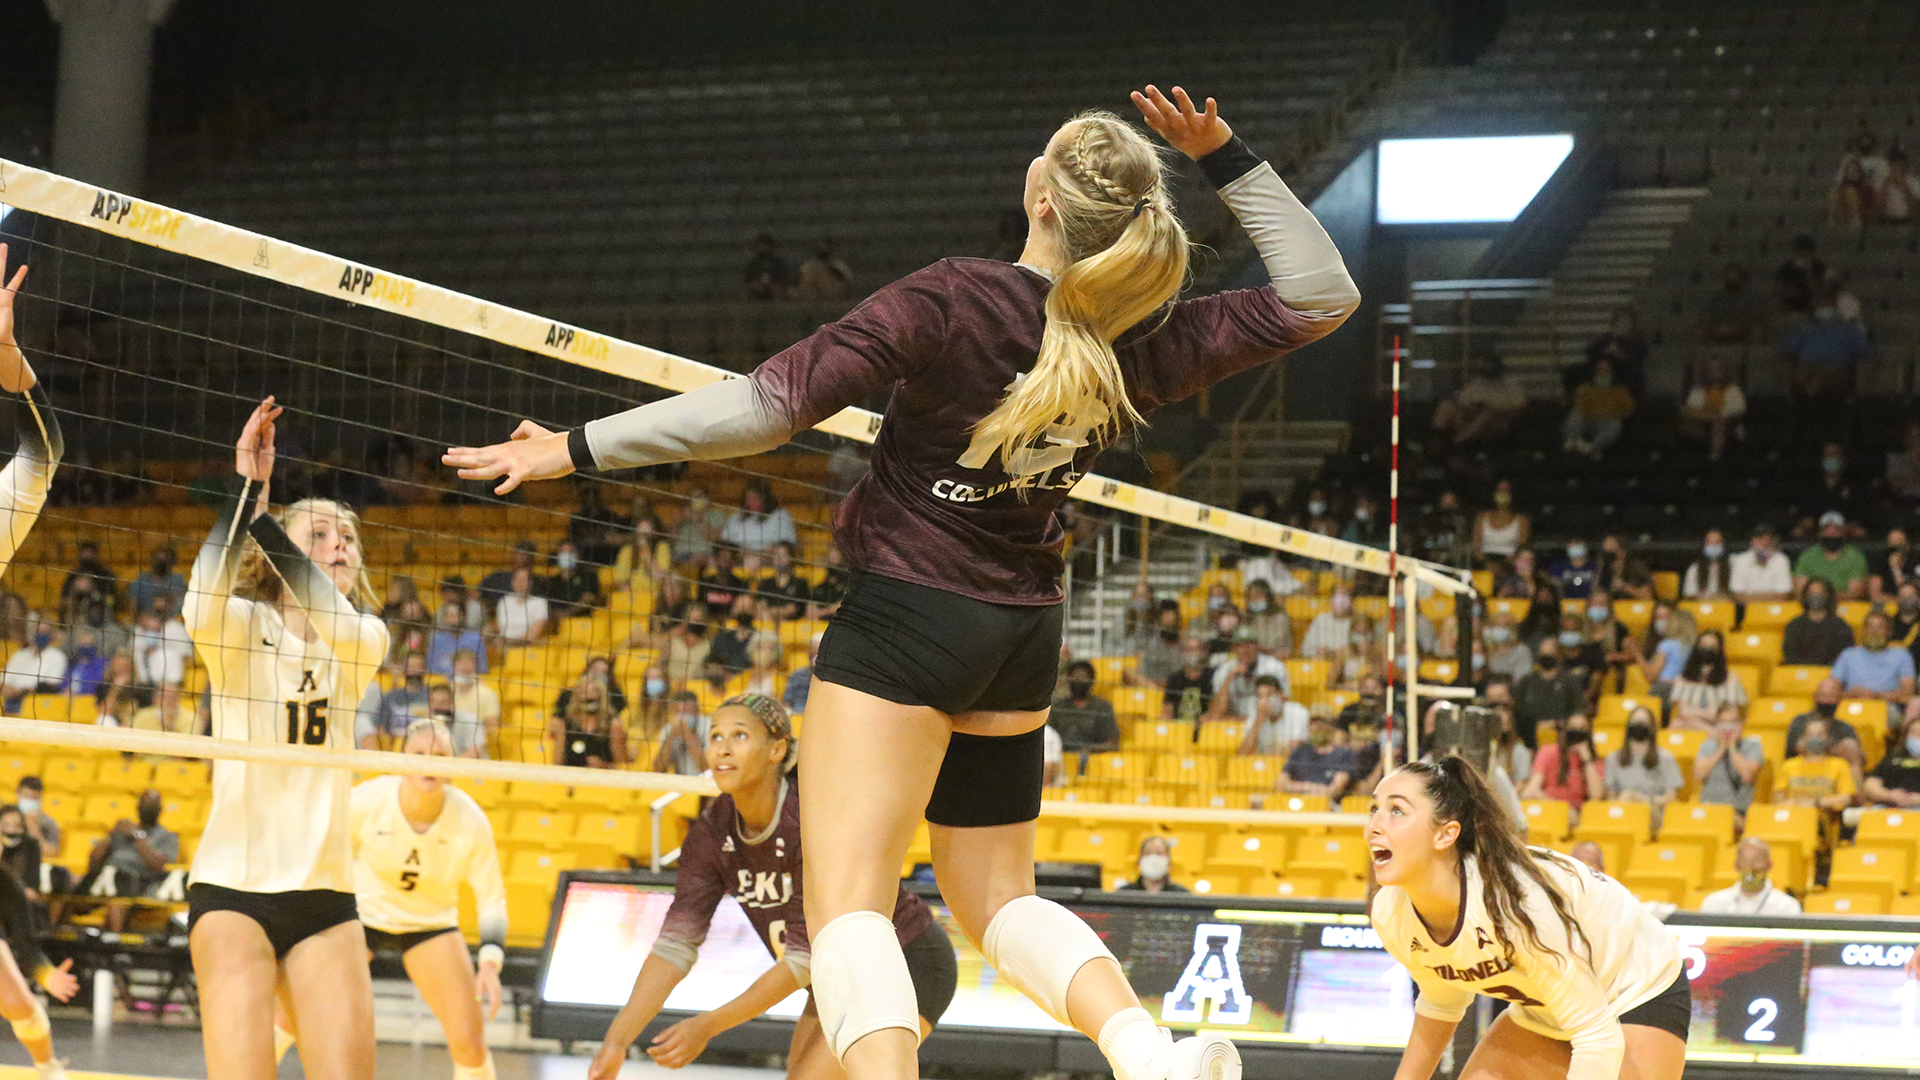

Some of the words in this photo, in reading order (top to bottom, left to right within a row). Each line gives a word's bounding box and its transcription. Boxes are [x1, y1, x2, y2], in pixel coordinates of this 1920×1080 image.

[286, 698, 328, 746] 16
[399, 871, 420, 892] 5
[1161, 923, 1253, 1026] A
[1743, 997, 1779, 1042] 2
